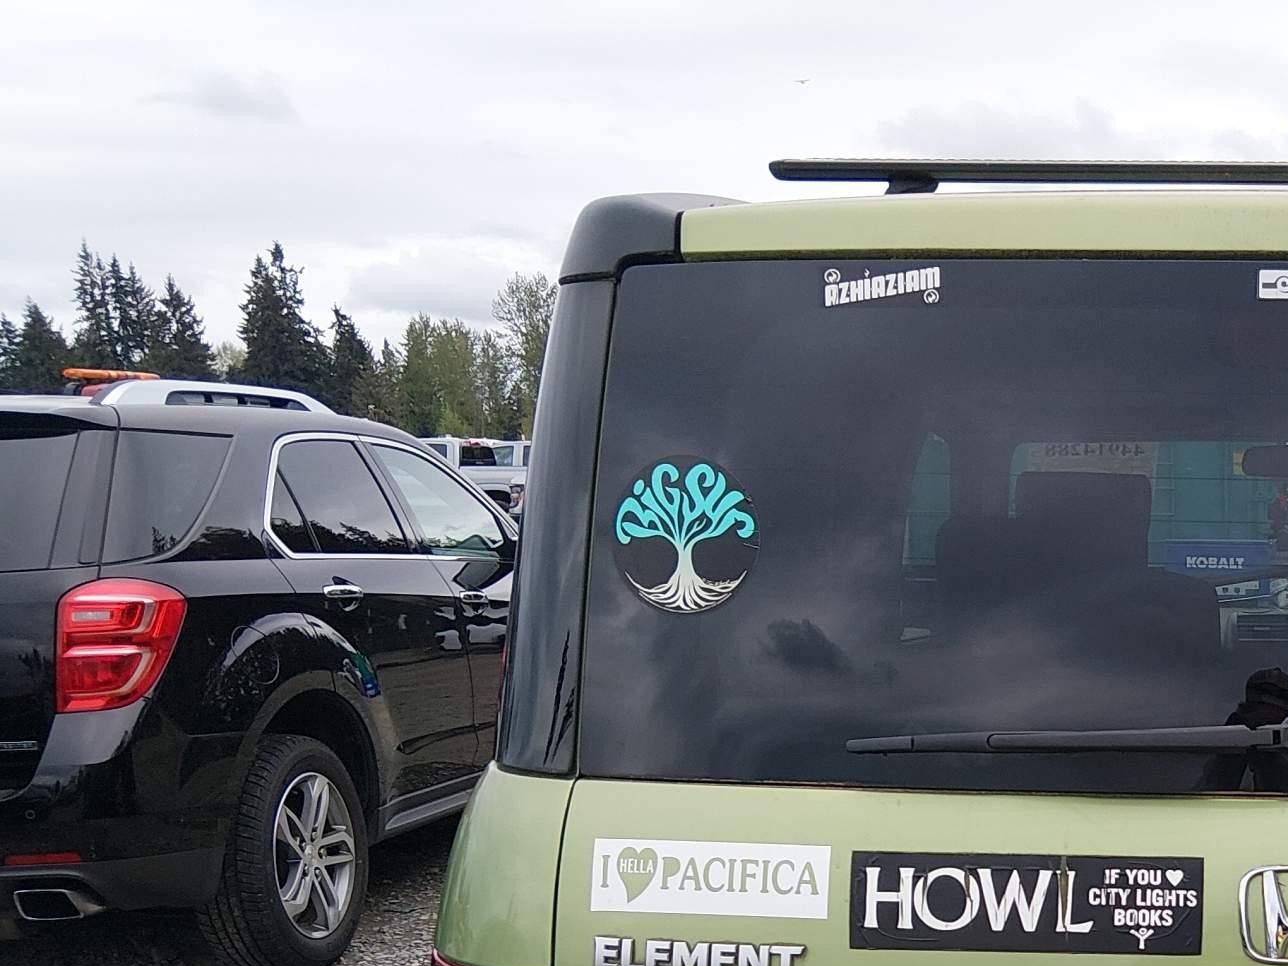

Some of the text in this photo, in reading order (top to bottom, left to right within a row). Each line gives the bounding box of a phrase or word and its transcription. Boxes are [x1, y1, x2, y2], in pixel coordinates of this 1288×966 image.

[1186, 556, 1245, 569] KOBALT
[600, 854, 820, 896] I HELLA PACIFICA
[1104, 869, 1163, 886] IF YOU
[863, 867, 1095, 933] HOWL
[1088, 887, 1199, 907] CITY LIGHTS
[1113, 908, 1174, 926] BOOKS
